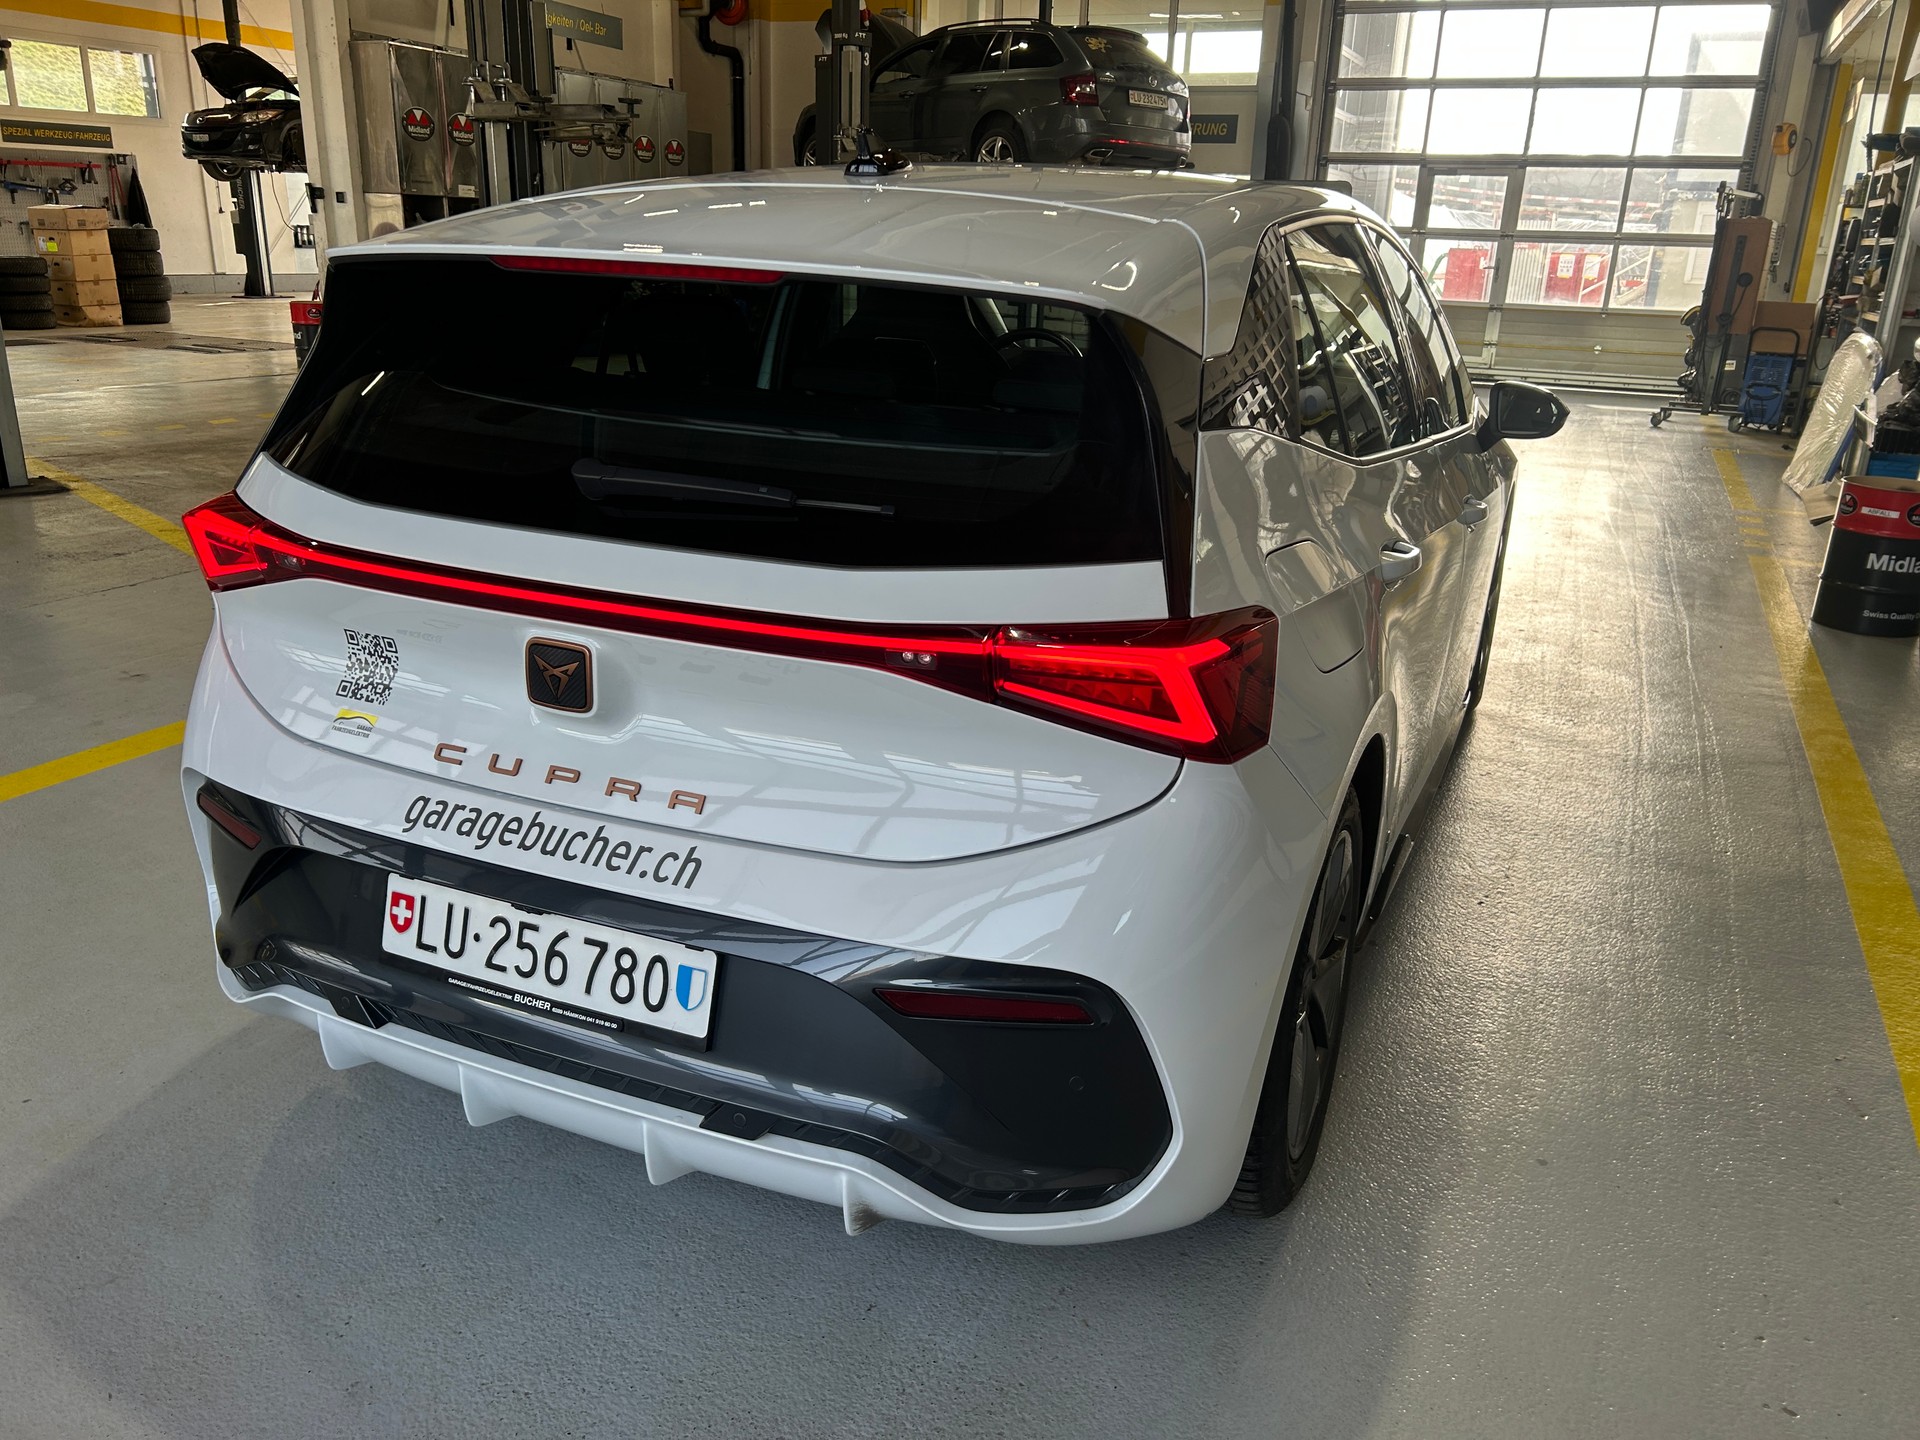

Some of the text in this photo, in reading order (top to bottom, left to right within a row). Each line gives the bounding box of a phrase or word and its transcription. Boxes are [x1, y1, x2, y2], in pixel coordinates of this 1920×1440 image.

[594, 23, 607, 36] Bar
[864, 52, 870, 66] 3
[3, 126, 32, 136] SPEZIAL
[408, 125, 430, 135] Midland
[1862, 609, 1889, 619] Swiss
[1890, 612, 1915, 620] Quality
[433, 742, 707, 815] CUPRA
[402, 794, 703, 890] garagebucher.ch
[513, 993, 551, 1011] BUCHER
